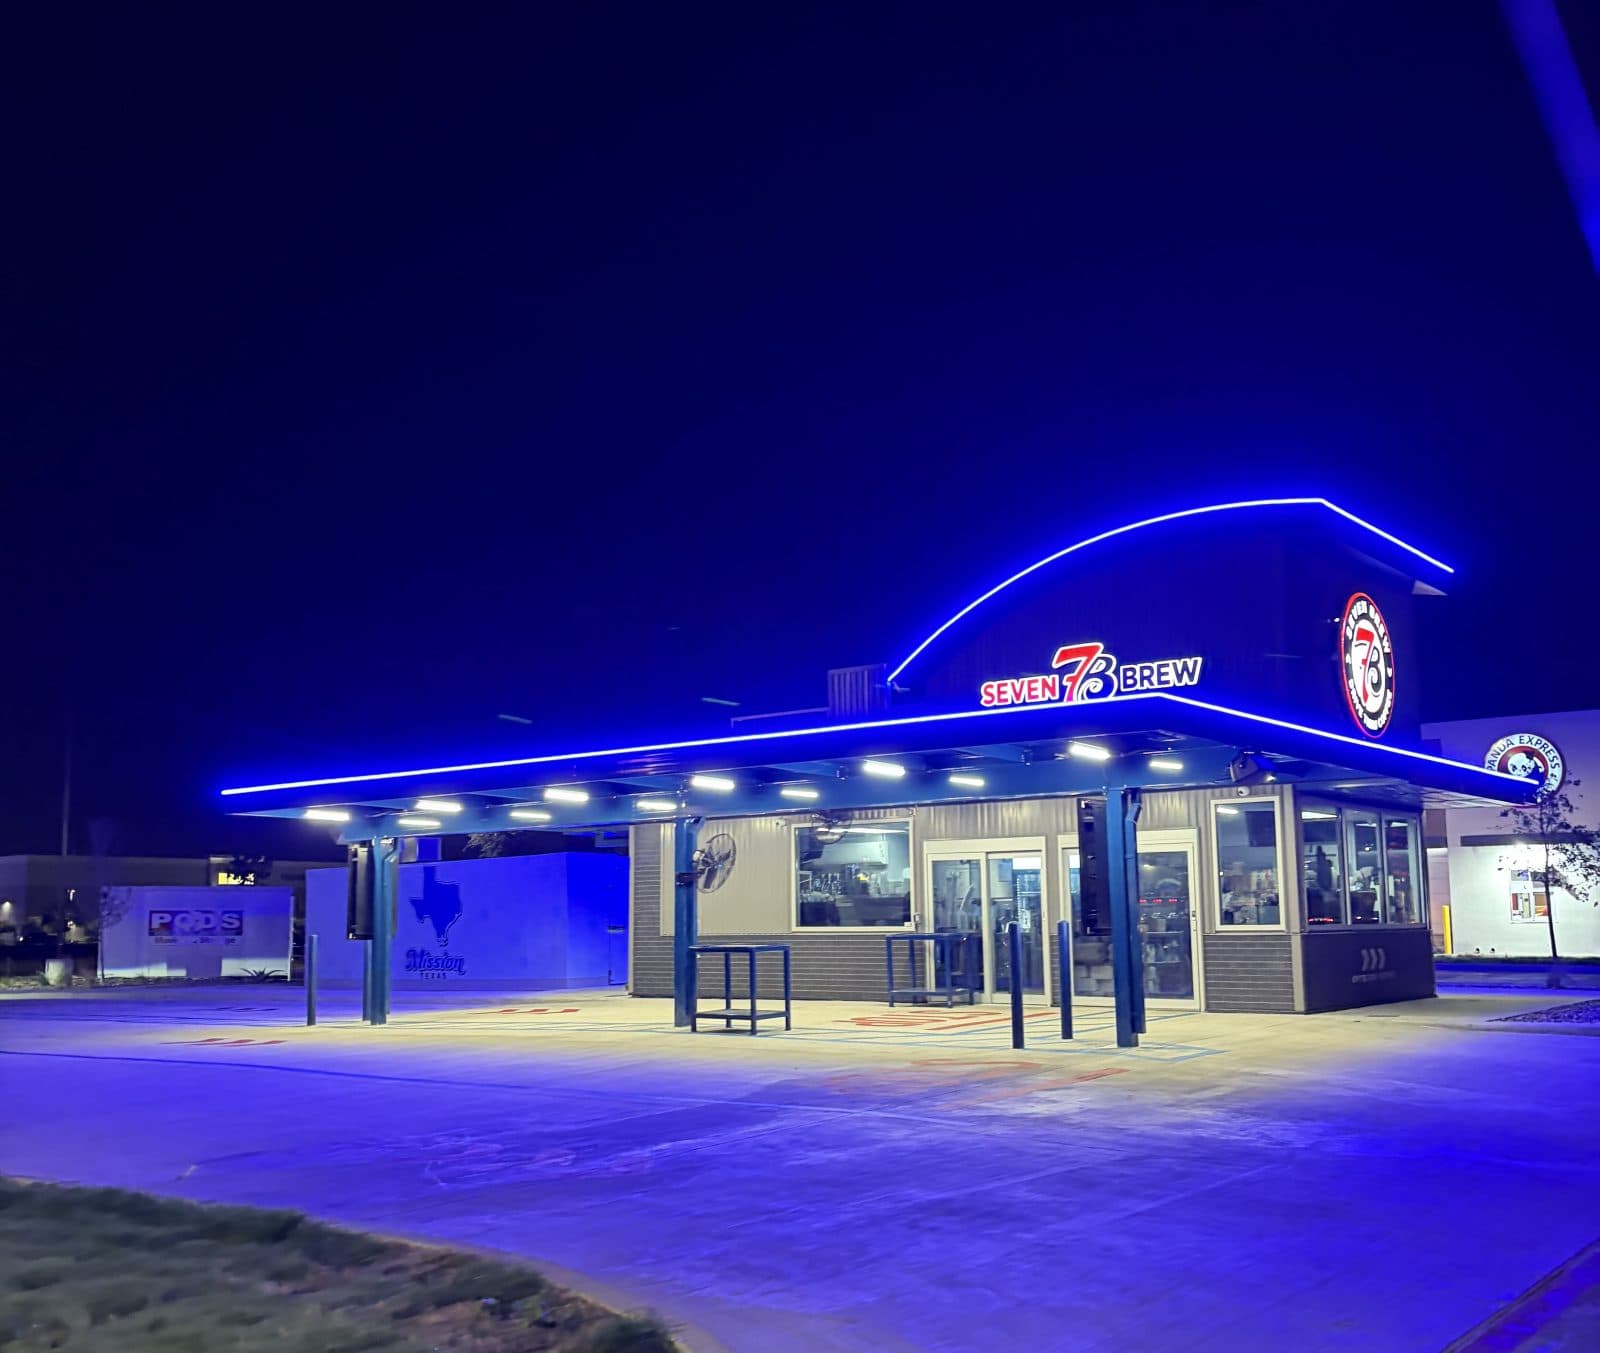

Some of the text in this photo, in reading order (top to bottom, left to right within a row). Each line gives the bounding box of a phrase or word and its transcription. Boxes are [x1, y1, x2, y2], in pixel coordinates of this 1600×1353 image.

[981, 675, 1059, 706] SEVEN
[1120, 657, 1202, 691] BREW
[1518, 735, 1560, 769] EXPRESS
[151, 912, 241, 929] PODS
[405, 949, 466, 976] Mission
